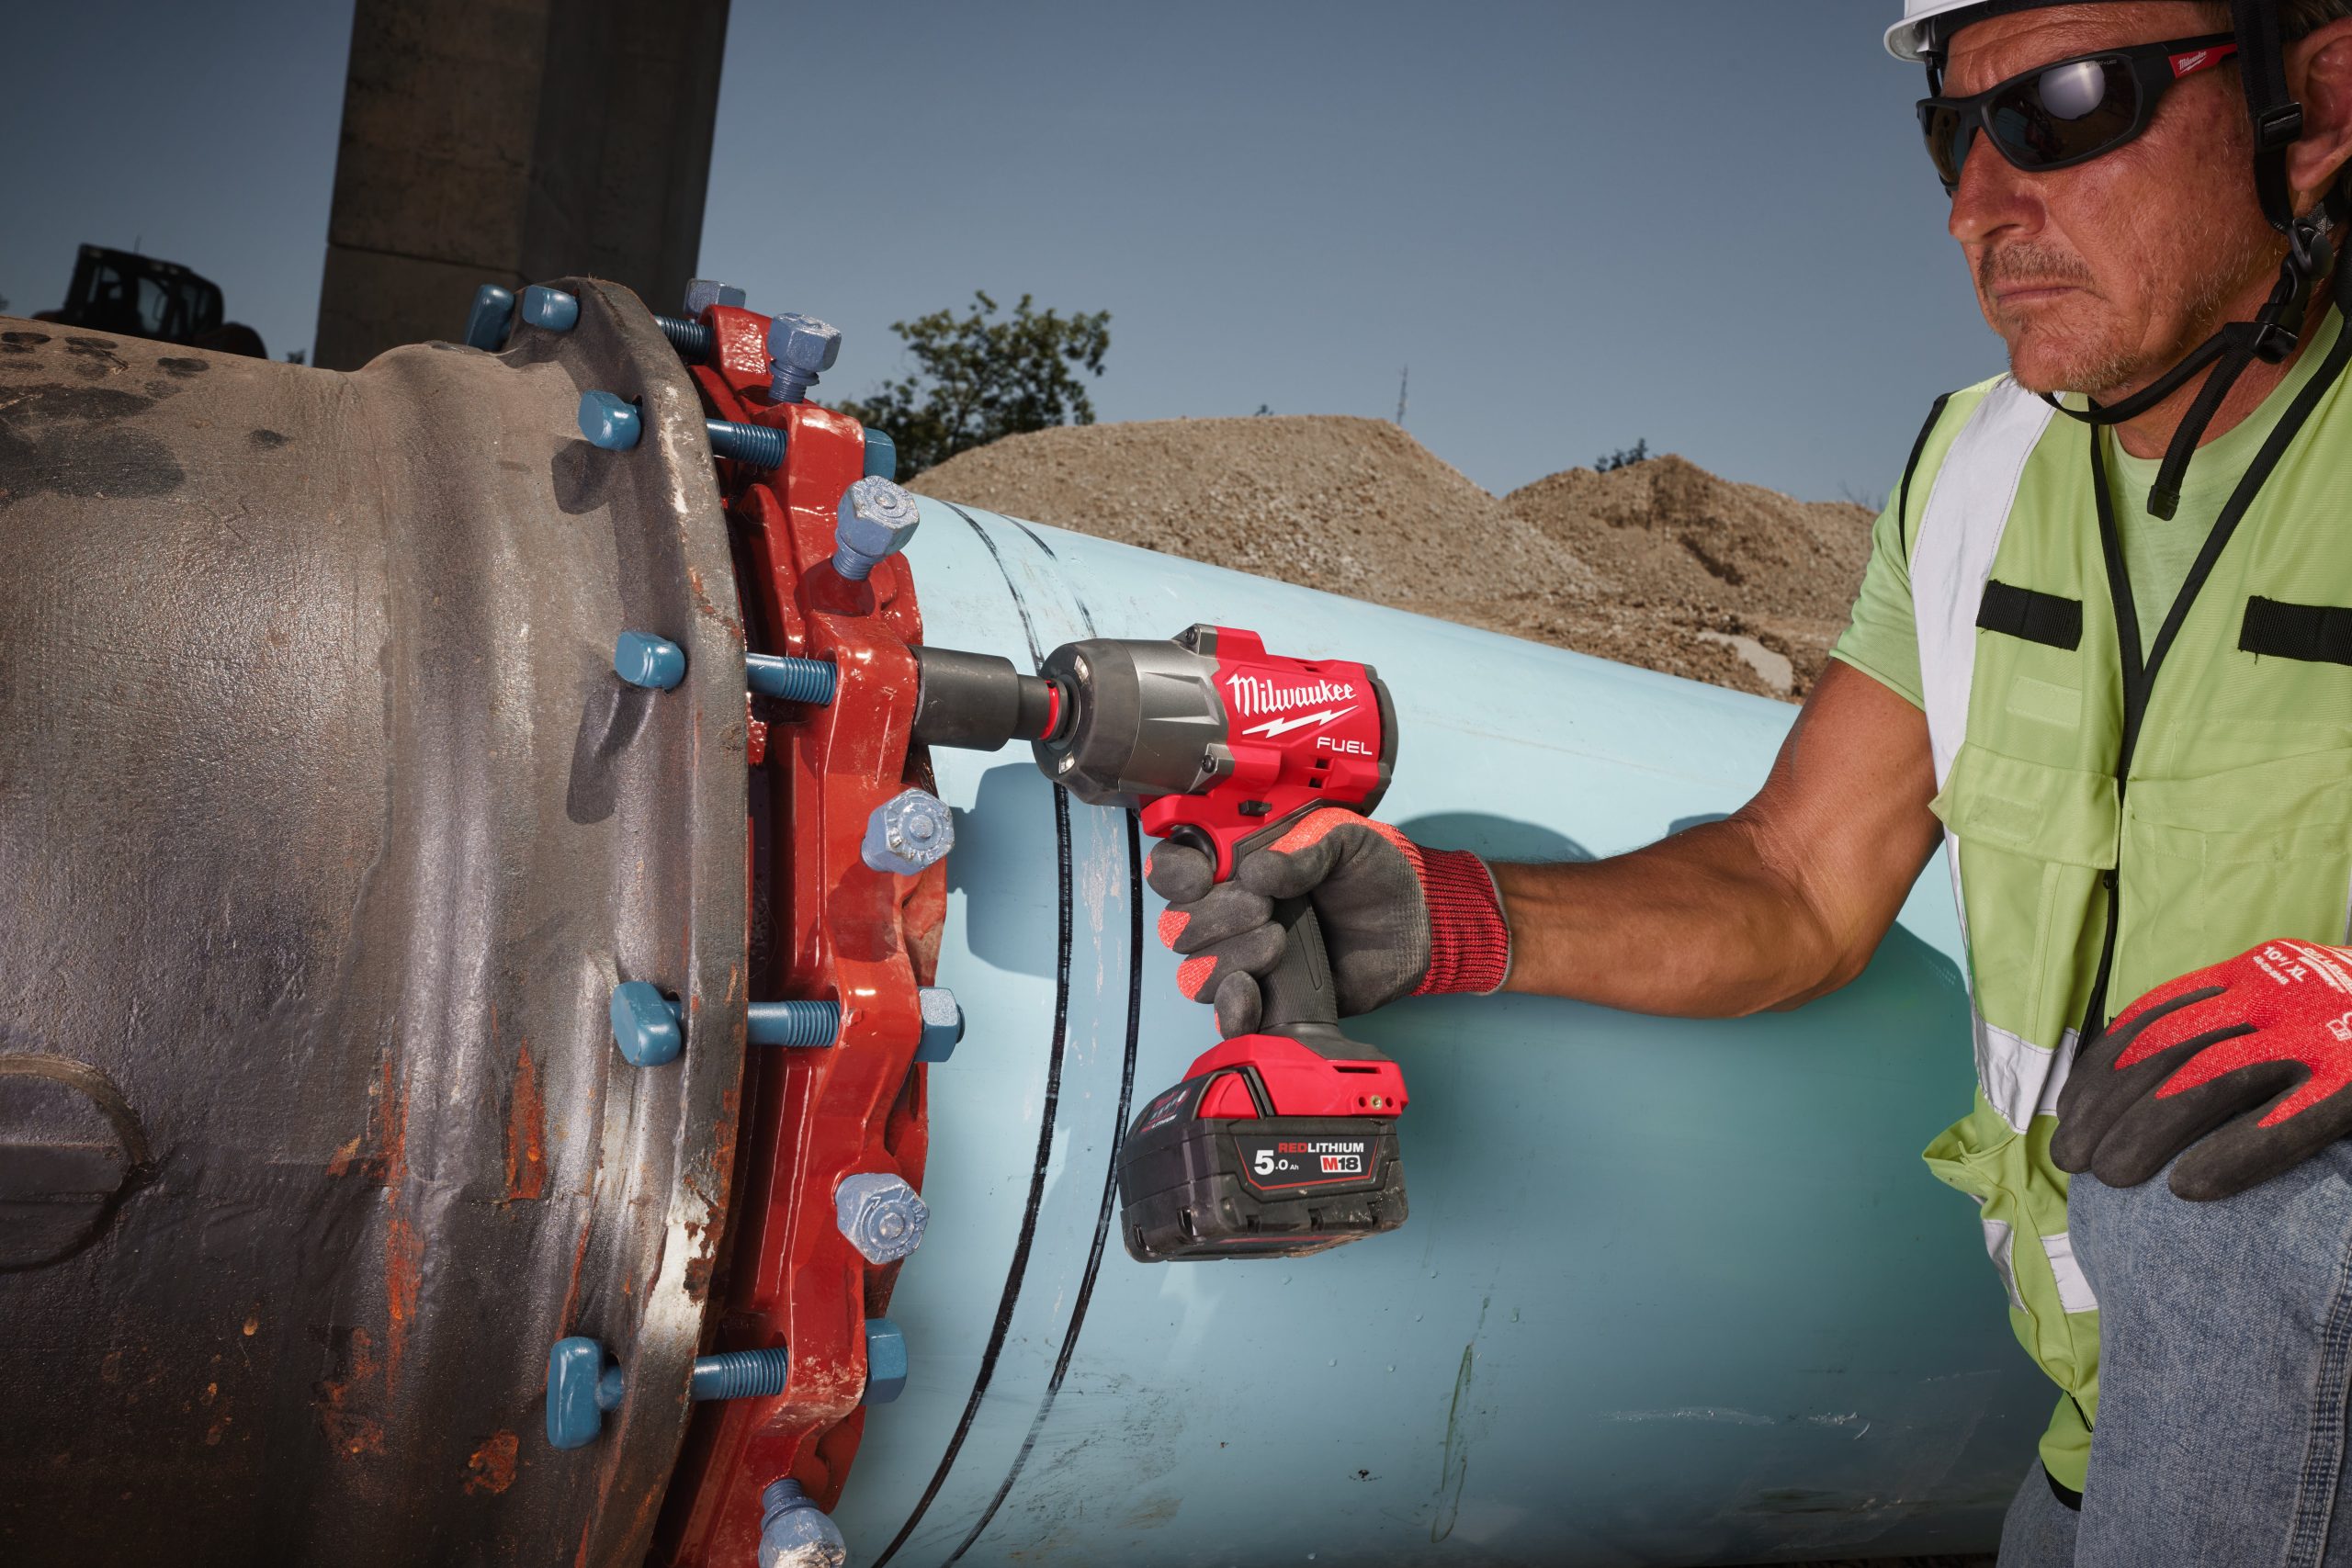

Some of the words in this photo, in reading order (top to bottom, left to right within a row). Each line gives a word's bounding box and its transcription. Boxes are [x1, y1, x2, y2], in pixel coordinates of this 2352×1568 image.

[1227, 673, 1358, 717] Milwaukee
[1317, 737, 1373, 755] FUEL
[1278, 1142, 1364, 1154] REDLITHIUM
[1322, 1156, 1360, 1171] M18
